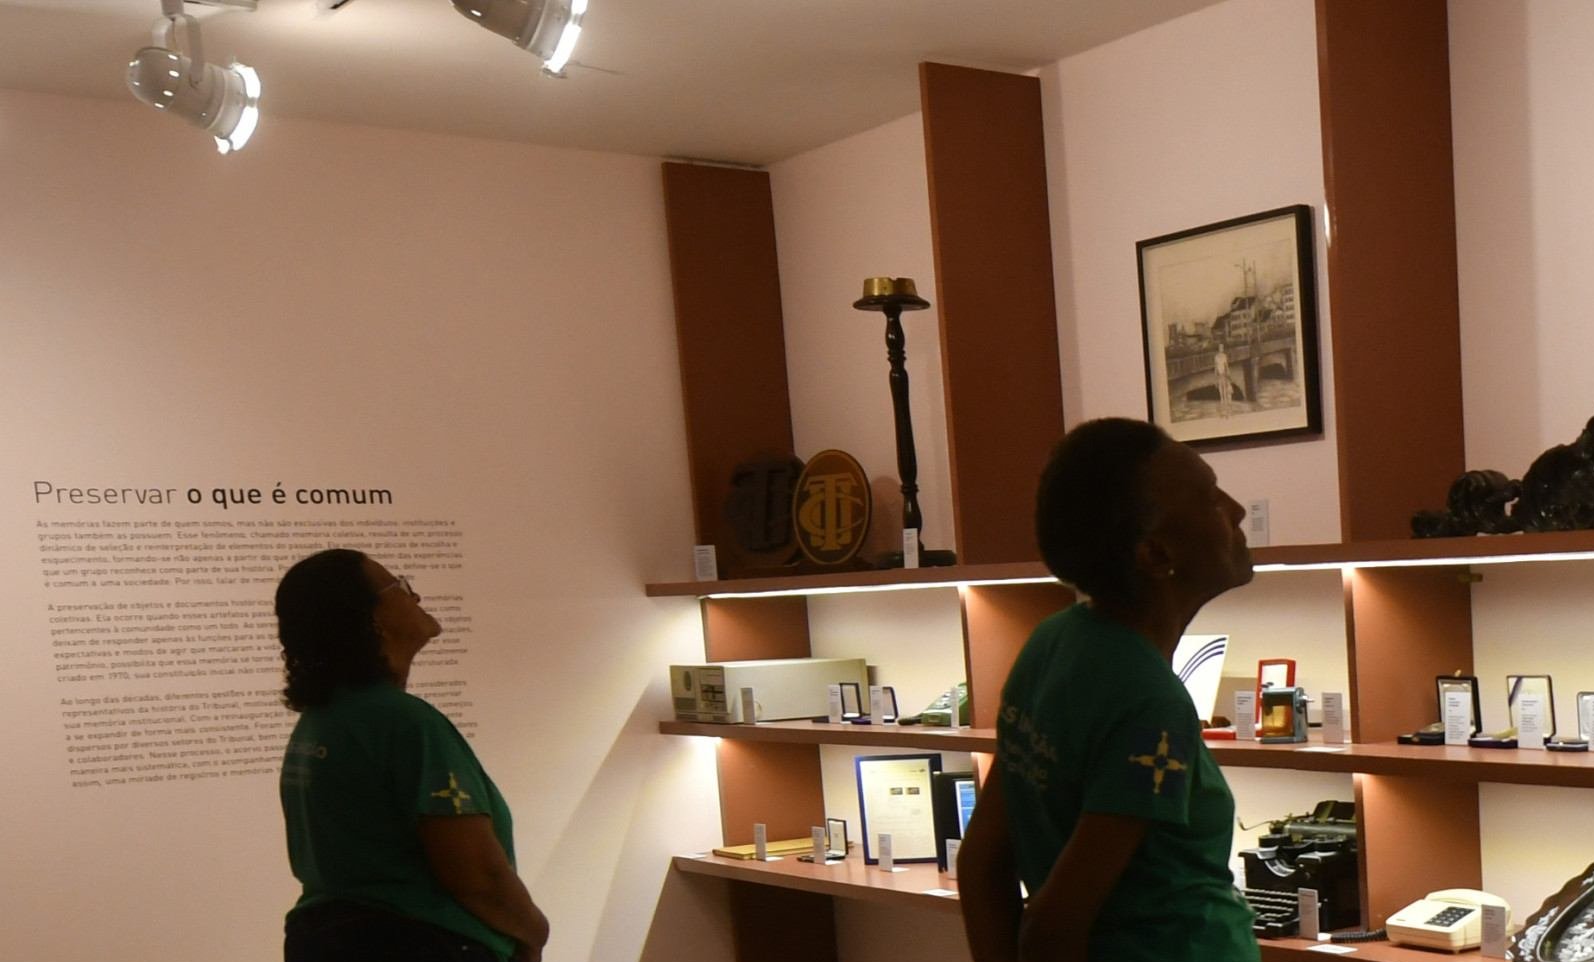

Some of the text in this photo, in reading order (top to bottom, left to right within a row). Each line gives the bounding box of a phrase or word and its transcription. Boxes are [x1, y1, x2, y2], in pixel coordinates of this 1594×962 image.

[33, 481, 393, 510] Preservar o que é comum
